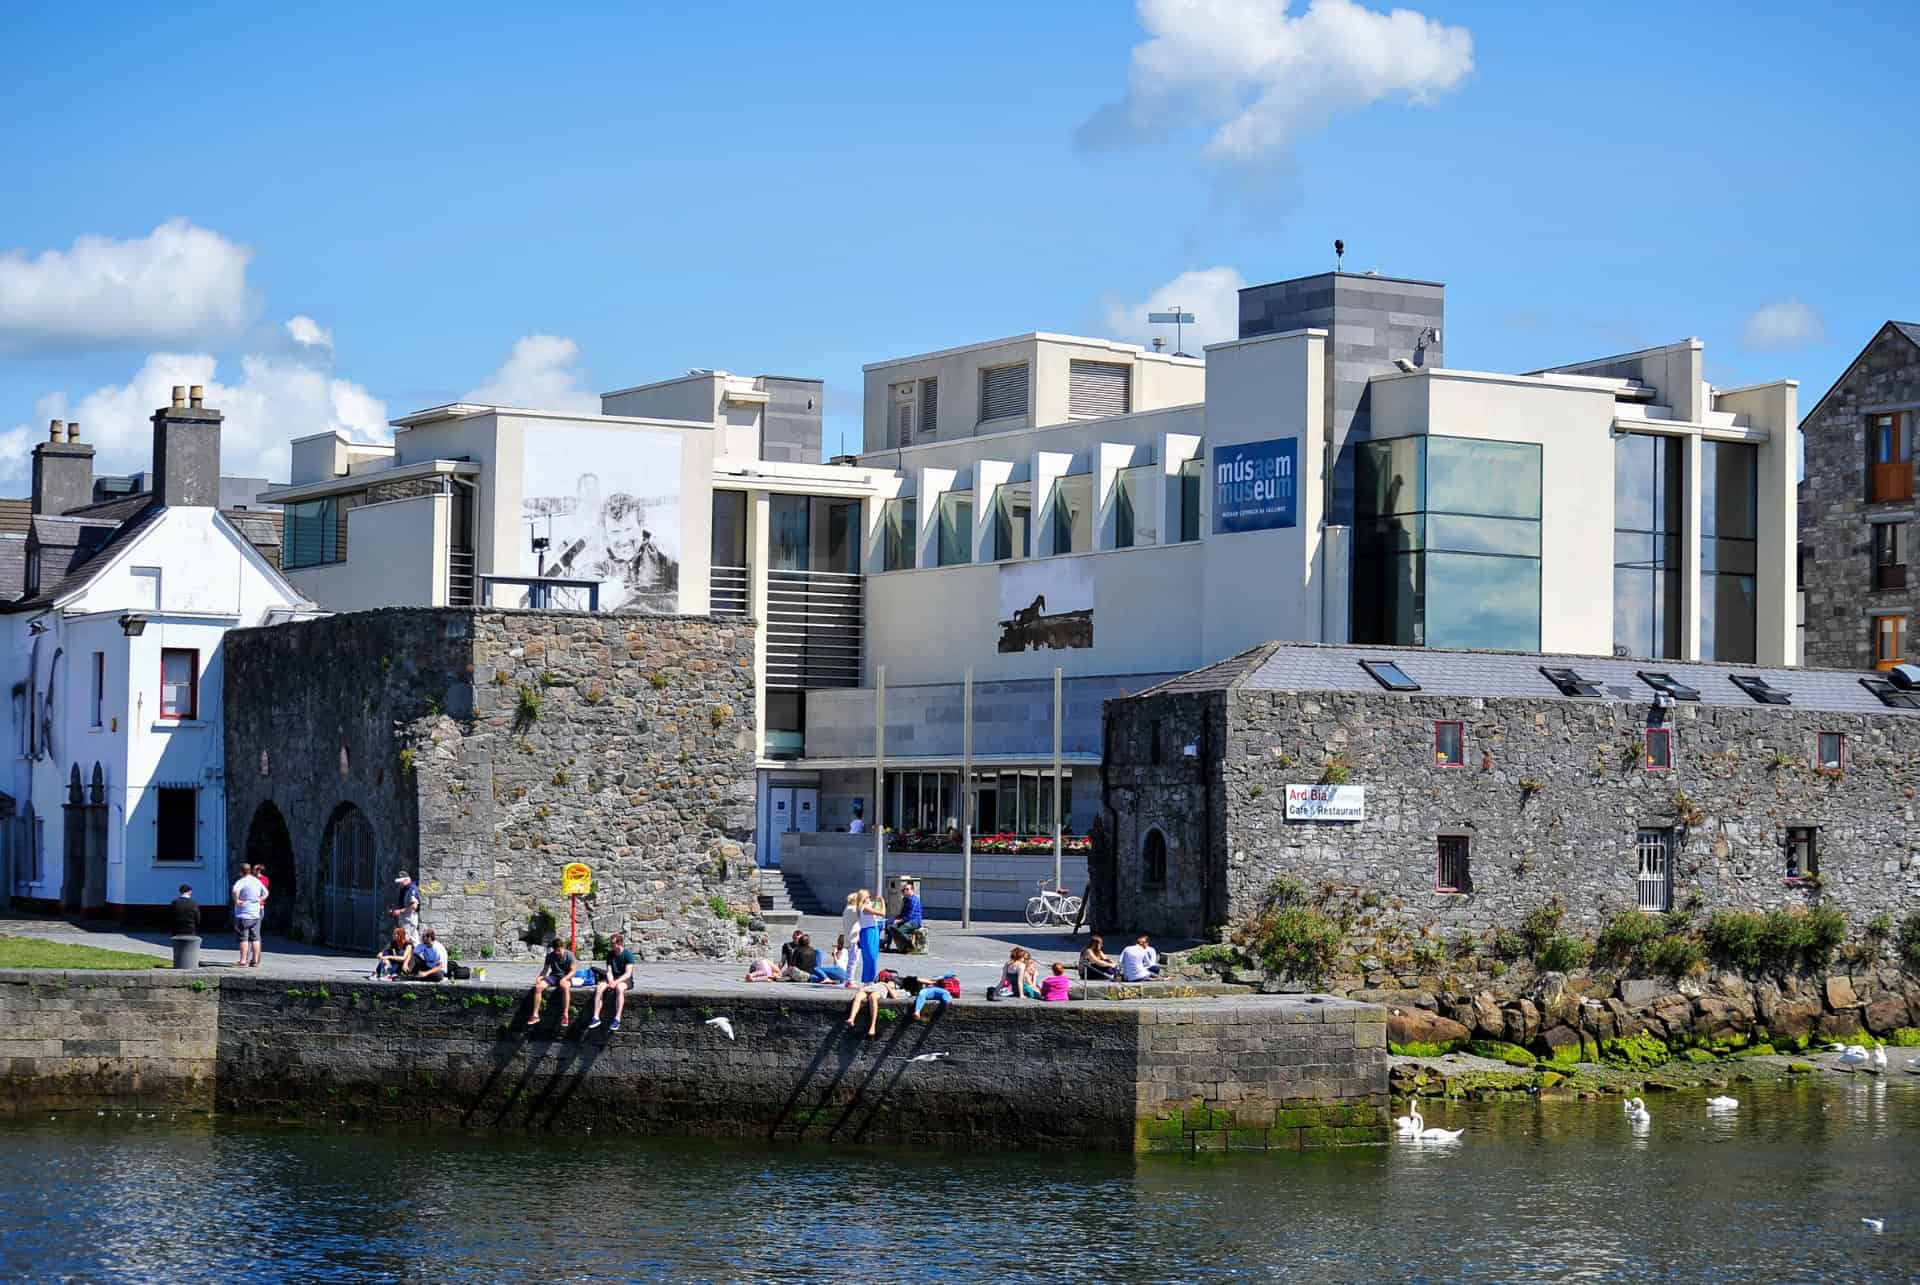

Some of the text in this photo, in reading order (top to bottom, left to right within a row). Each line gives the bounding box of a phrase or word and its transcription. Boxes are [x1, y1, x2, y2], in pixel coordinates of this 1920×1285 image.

[1218, 453, 1291, 483] músaem
[1217, 477, 1291, 504] museum
[1289, 789, 1307, 801] Ard
[1311, 789, 1327, 801] Bia
[1317, 805, 1361, 816] Restaurant
